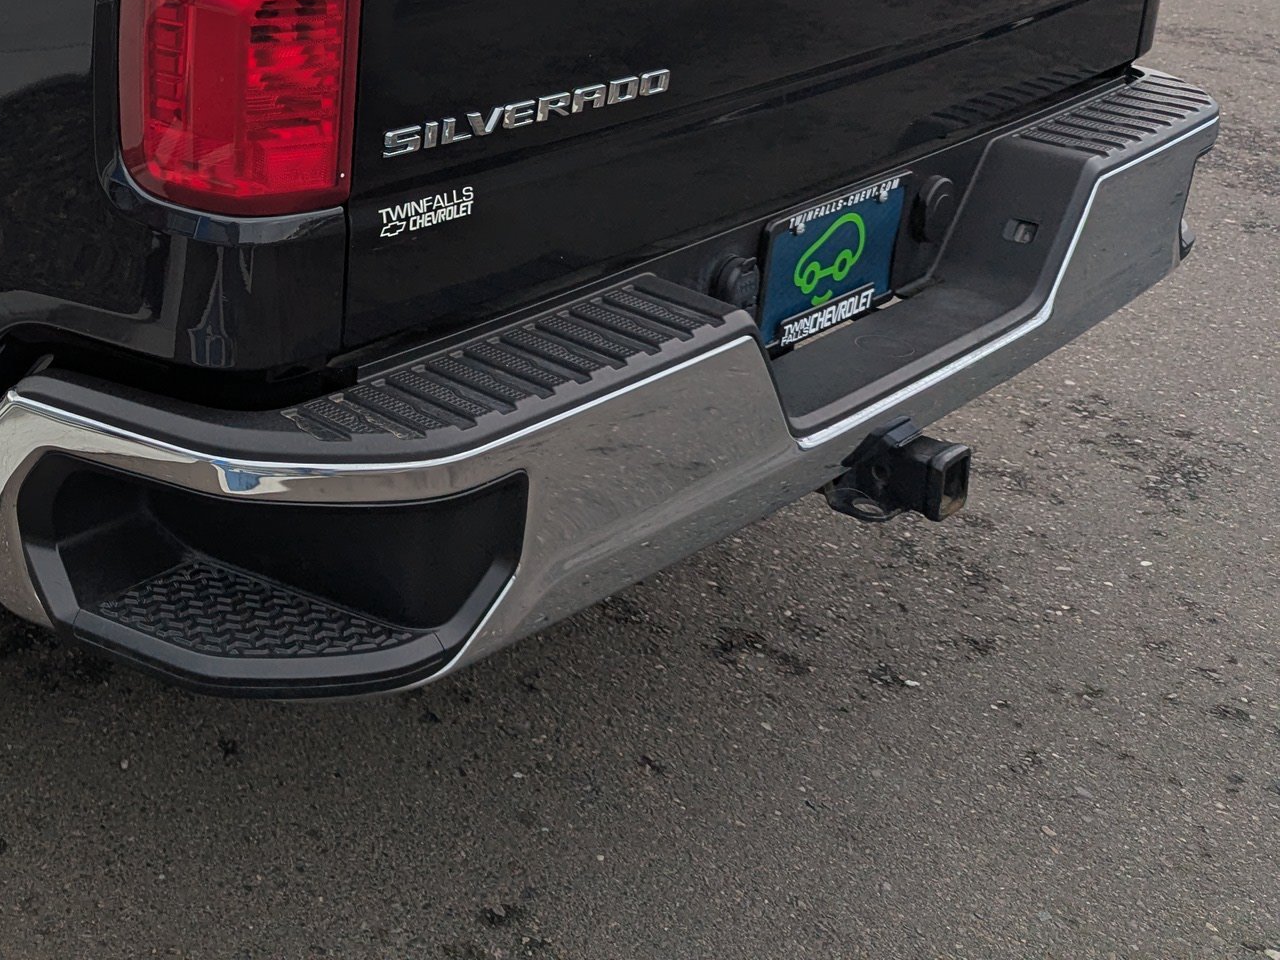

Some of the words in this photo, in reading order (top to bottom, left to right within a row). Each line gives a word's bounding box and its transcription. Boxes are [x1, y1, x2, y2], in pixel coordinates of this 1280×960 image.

[383, 68, 670, 158] SILVERADO
[409, 201, 473, 232] CHEVROLET
[789, 178, 900, 227] TWINFALLS-CHEVY.COM
[783, 315, 810, 338] TWIN
[808, 289, 874, 333] CHEVROLET
[780, 327, 810, 347] FALLS
